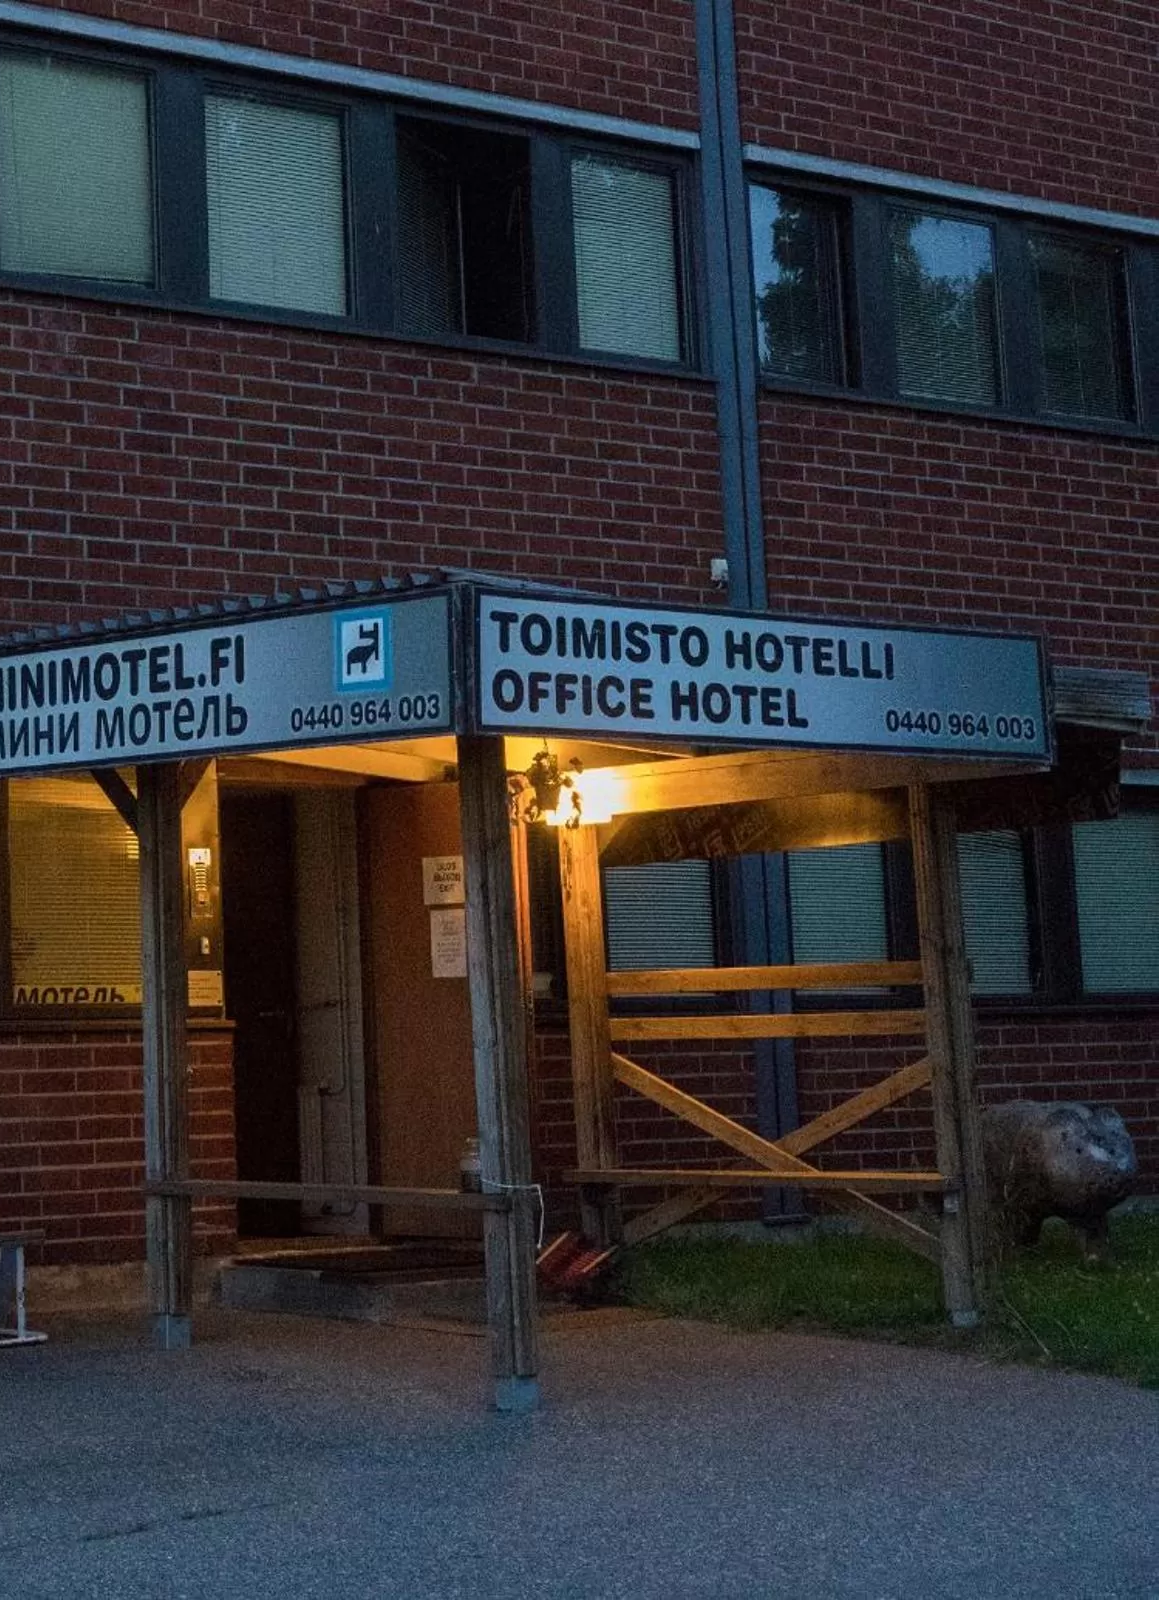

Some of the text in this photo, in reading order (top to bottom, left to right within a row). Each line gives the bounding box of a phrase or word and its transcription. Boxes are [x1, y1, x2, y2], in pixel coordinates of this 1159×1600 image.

[490, 610, 894, 680] TOIMISTO HOTELLI
[291, 694, 440, 733] 0440 964 003
[491, 668, 809, 729] OFFICE HOTEL
[885, 708, 1036, 742] 0440 964 003
